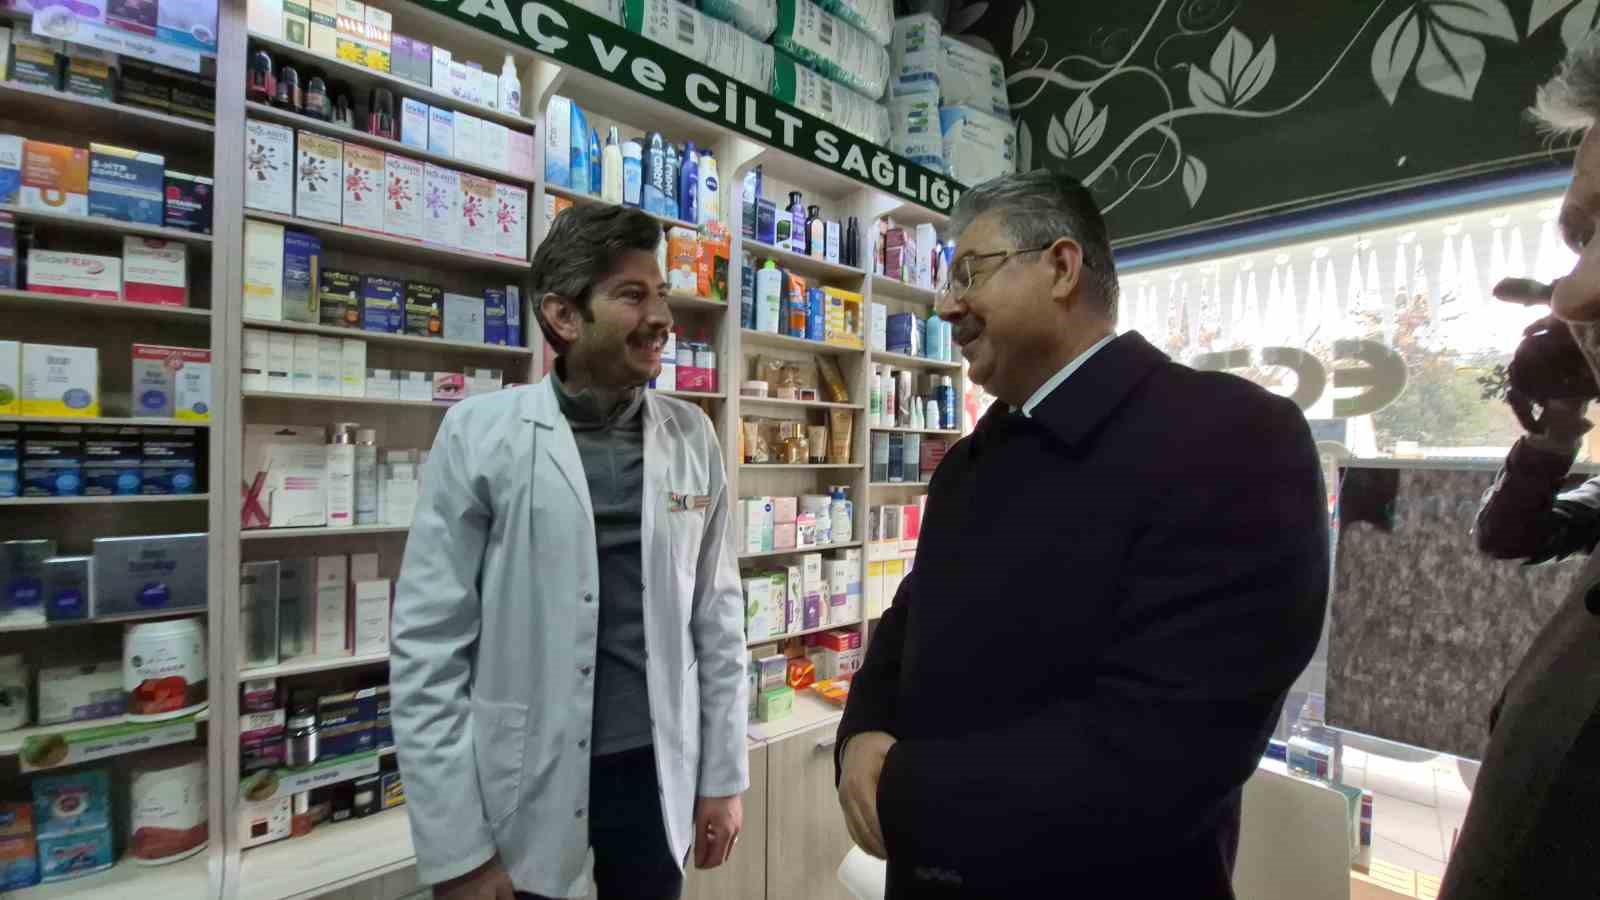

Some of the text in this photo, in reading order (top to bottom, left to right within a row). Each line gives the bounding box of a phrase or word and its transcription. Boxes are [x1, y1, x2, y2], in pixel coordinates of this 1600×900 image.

[431, 0, 568, 54] AÇ
[588, 33, 667, 91] ve
[685, 72, 803, 148] CİLT
